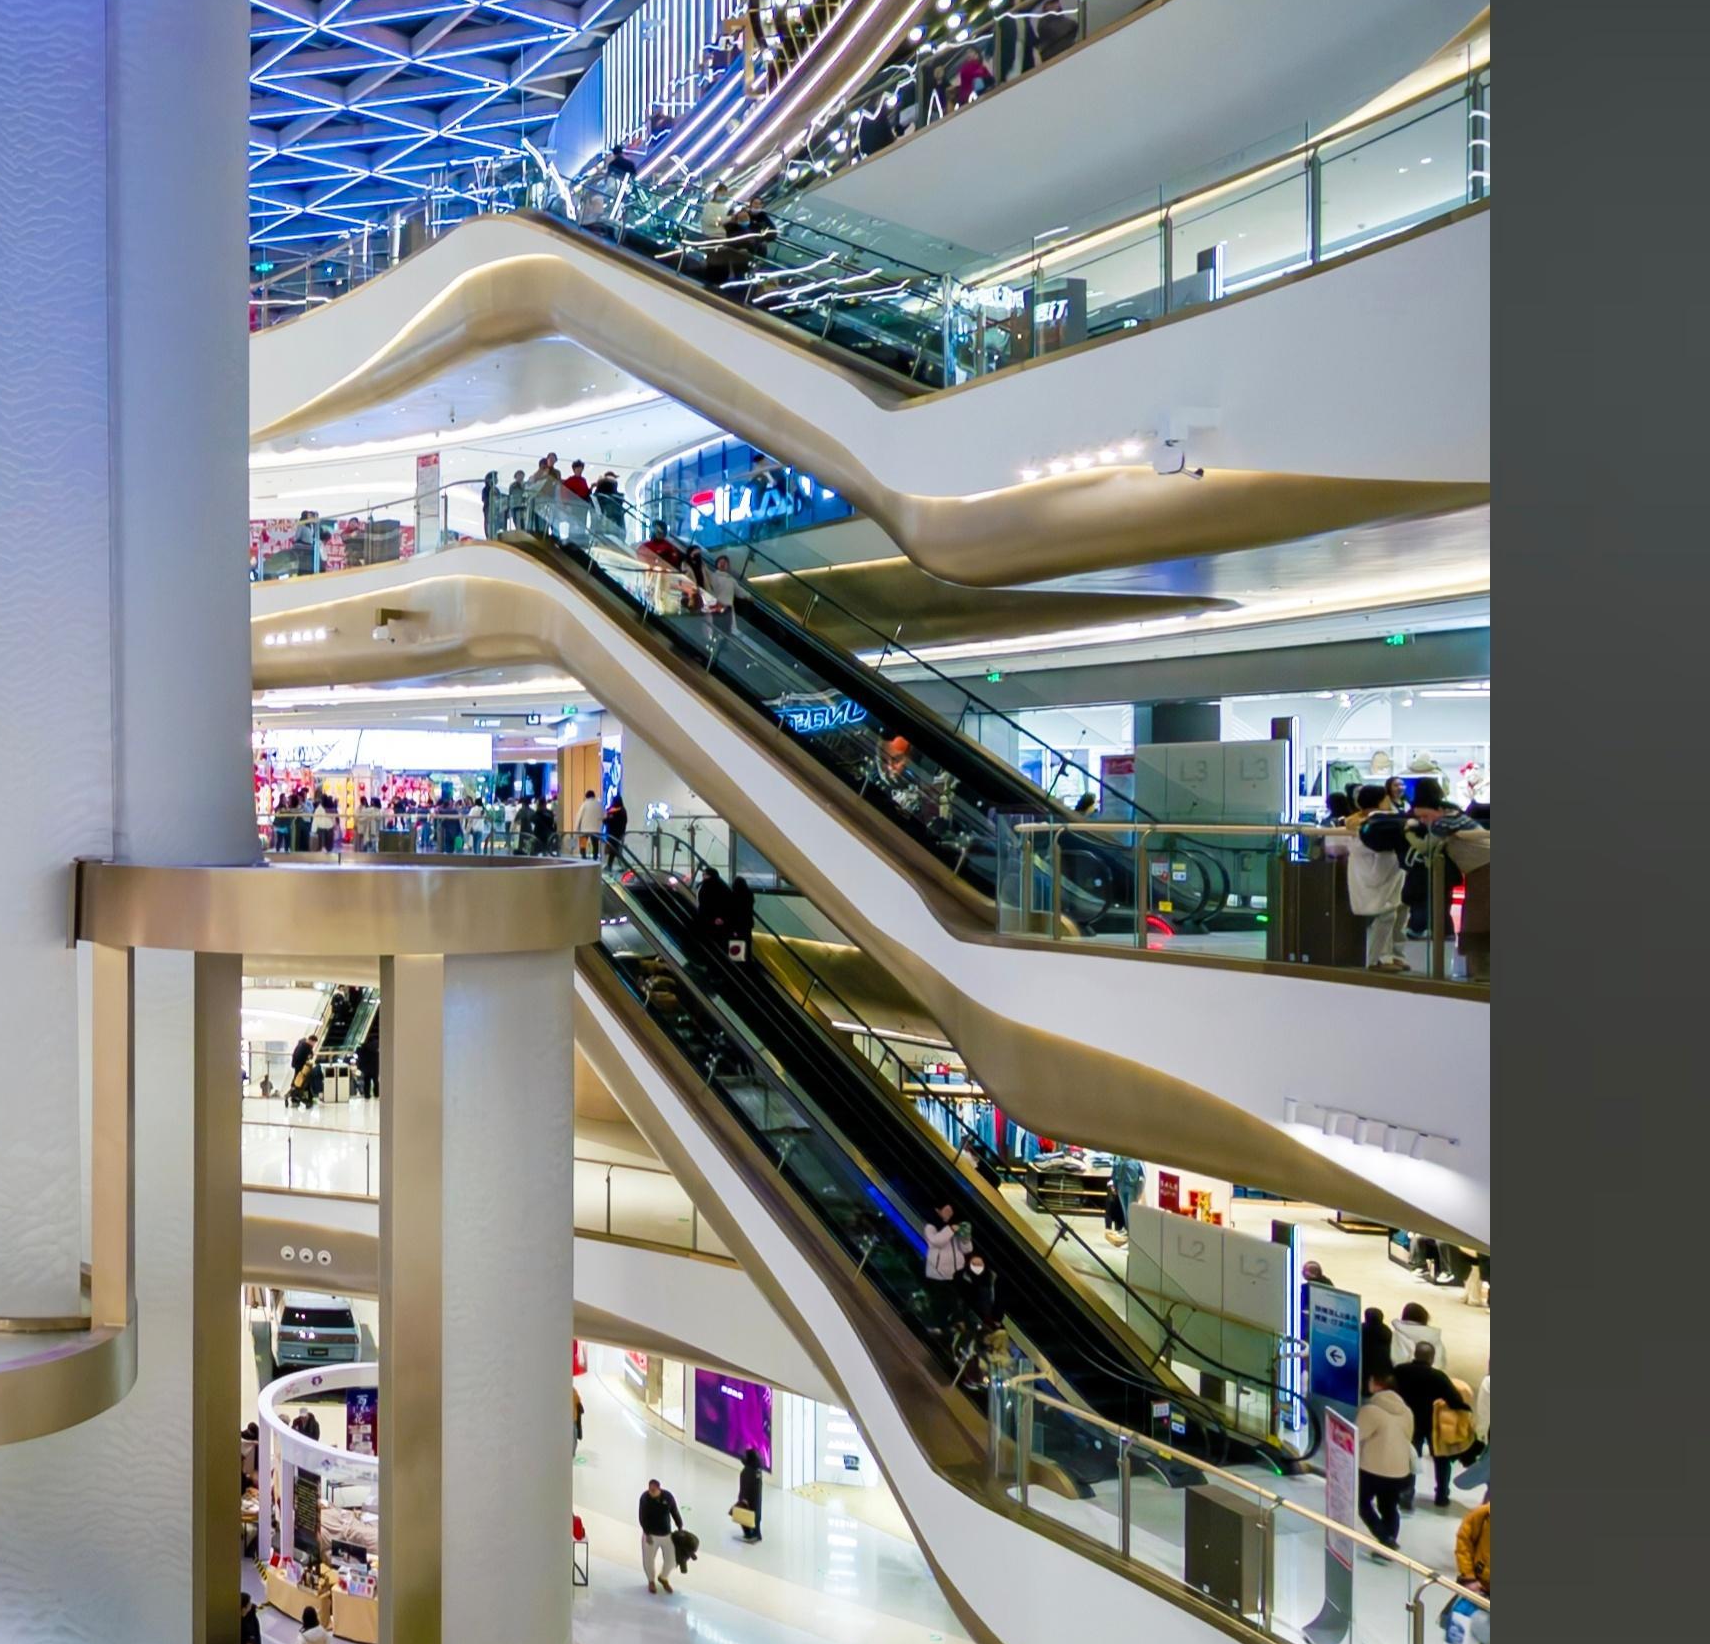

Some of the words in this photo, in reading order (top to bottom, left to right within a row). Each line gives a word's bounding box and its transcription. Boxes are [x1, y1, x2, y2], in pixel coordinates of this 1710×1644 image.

[1179, 760, 1208, 782] L3
[1240, 758, 1269, 780] L3
[1178, 1236, 1206, 1262] L2
[1240, 1255, 1270, 1280] L2
